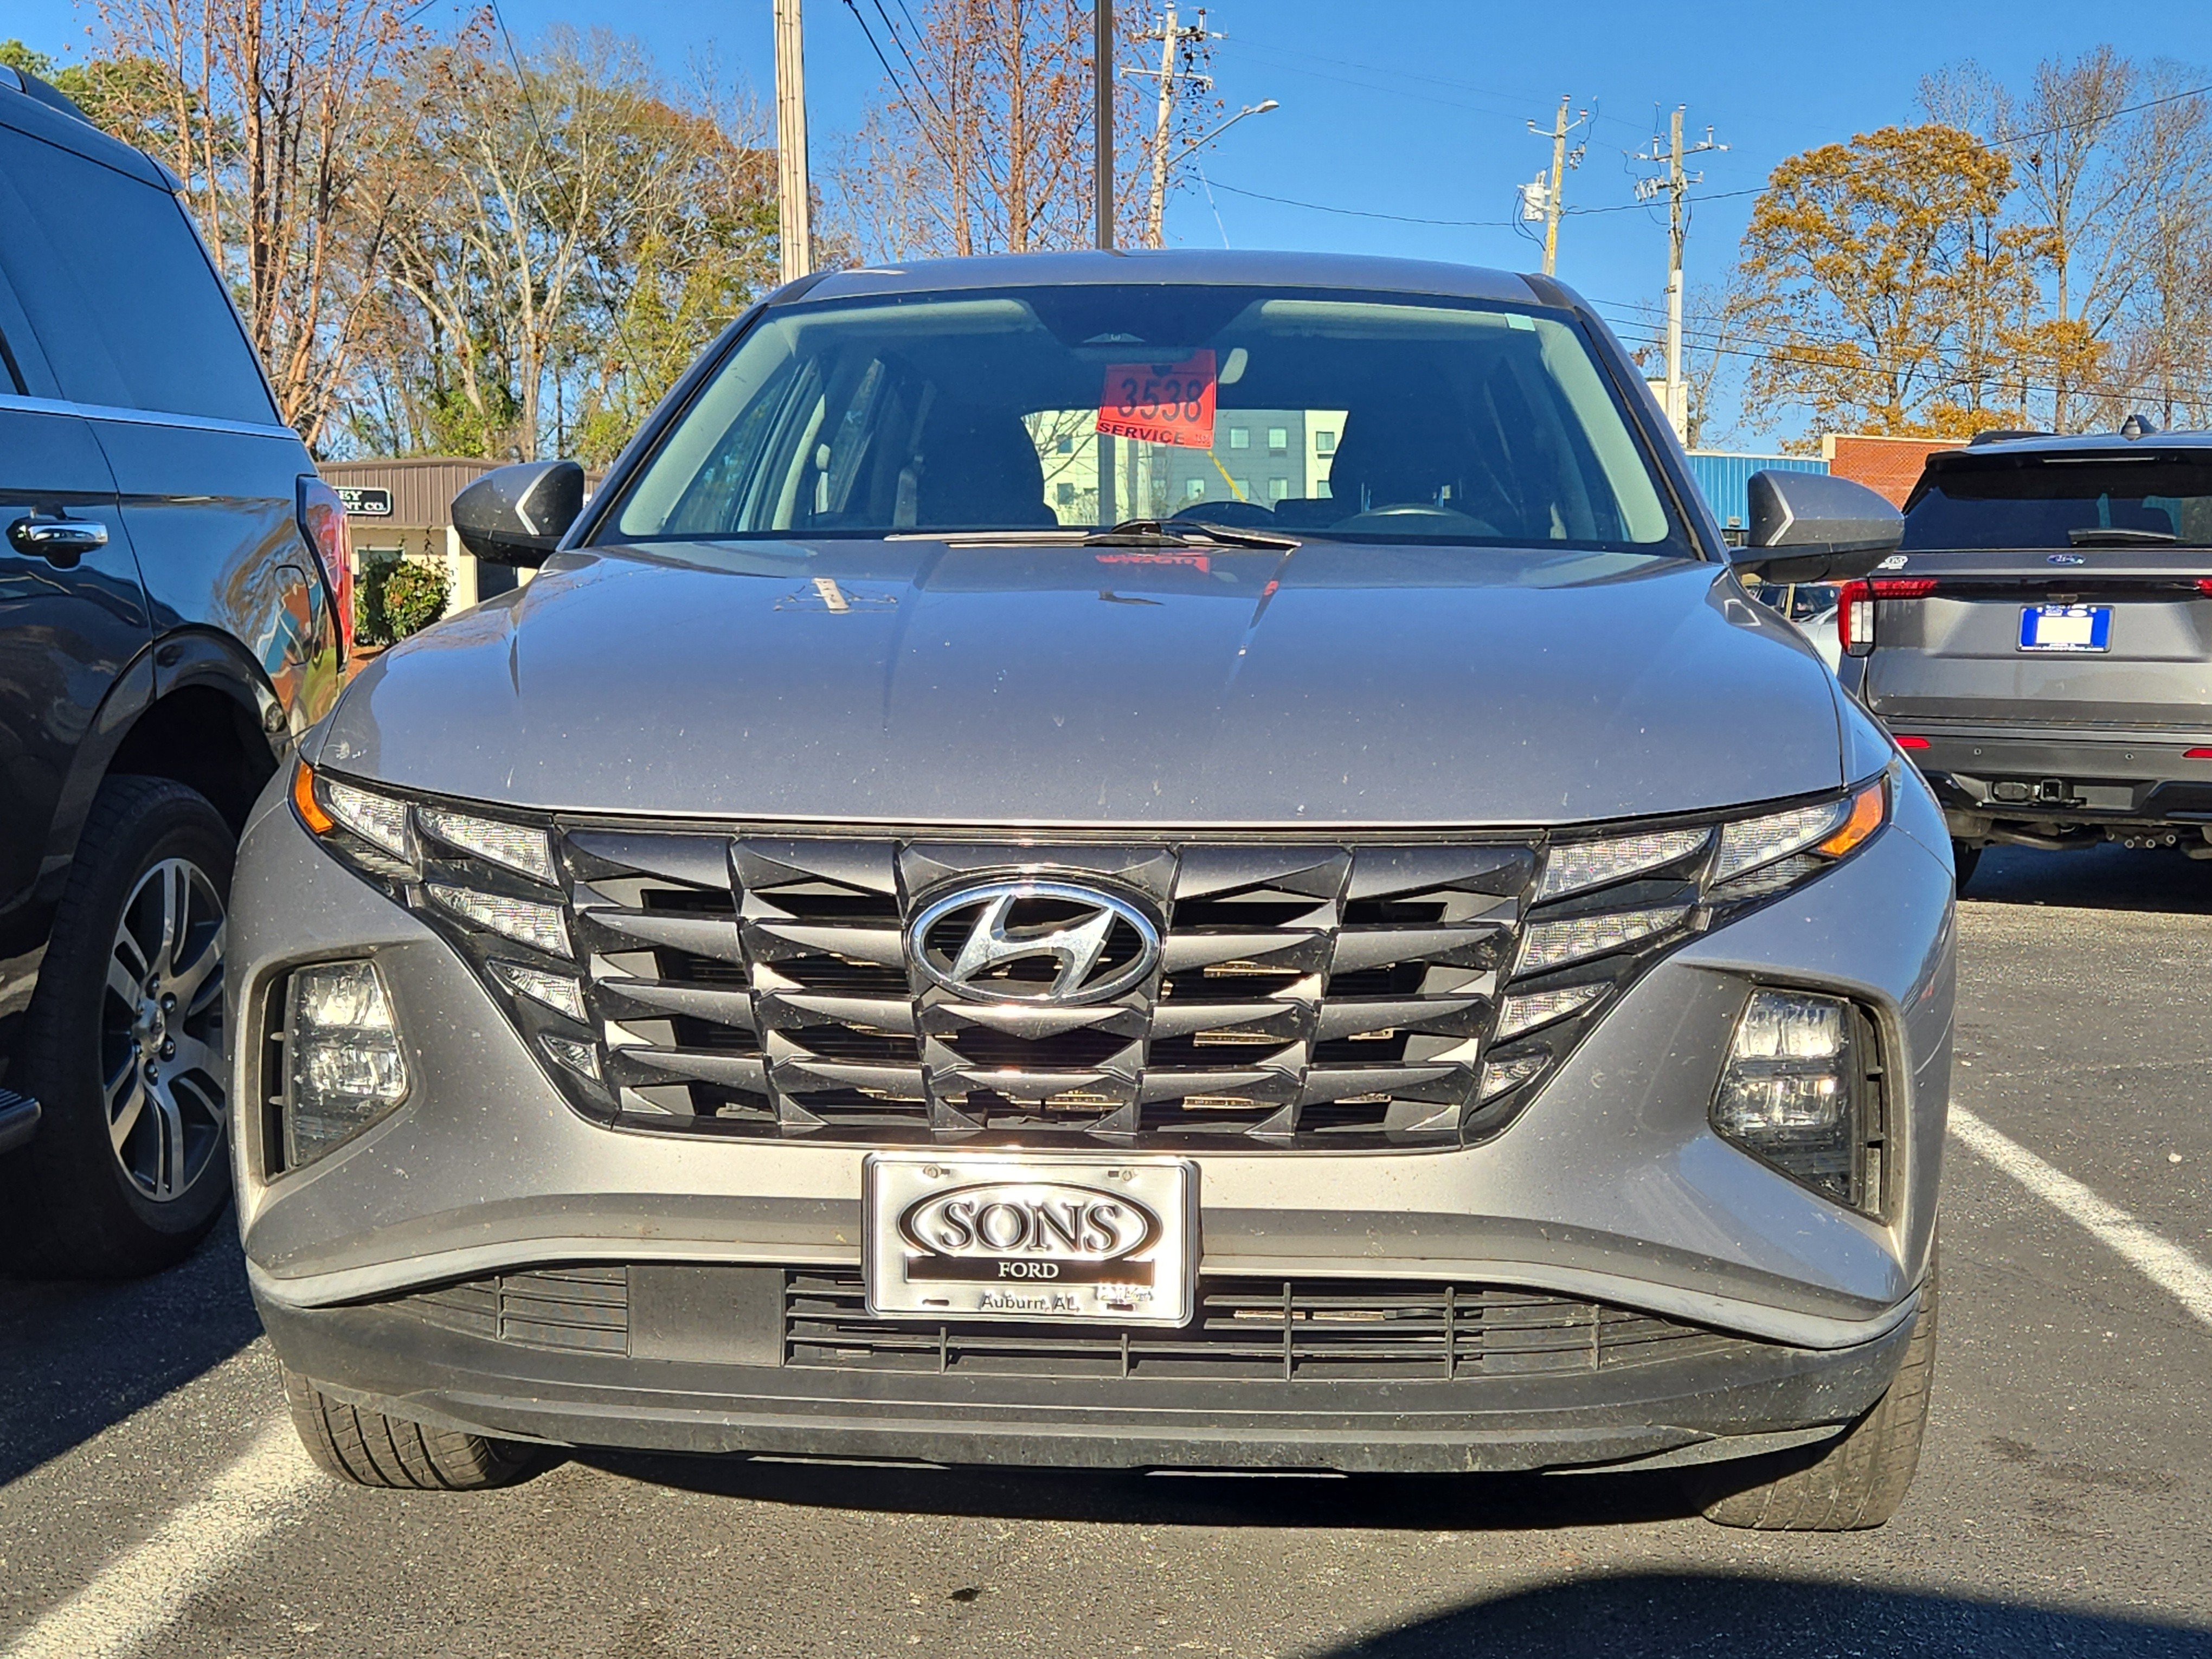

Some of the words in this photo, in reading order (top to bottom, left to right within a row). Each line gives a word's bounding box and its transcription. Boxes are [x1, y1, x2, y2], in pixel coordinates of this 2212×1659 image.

[1117, 377, 1203, 423] 3538
[1099, 422, 1185, 445] SERVICE
[940, 1201, 1117, 1253] SONS
[998, 1262, 1059, 1278] FORD
